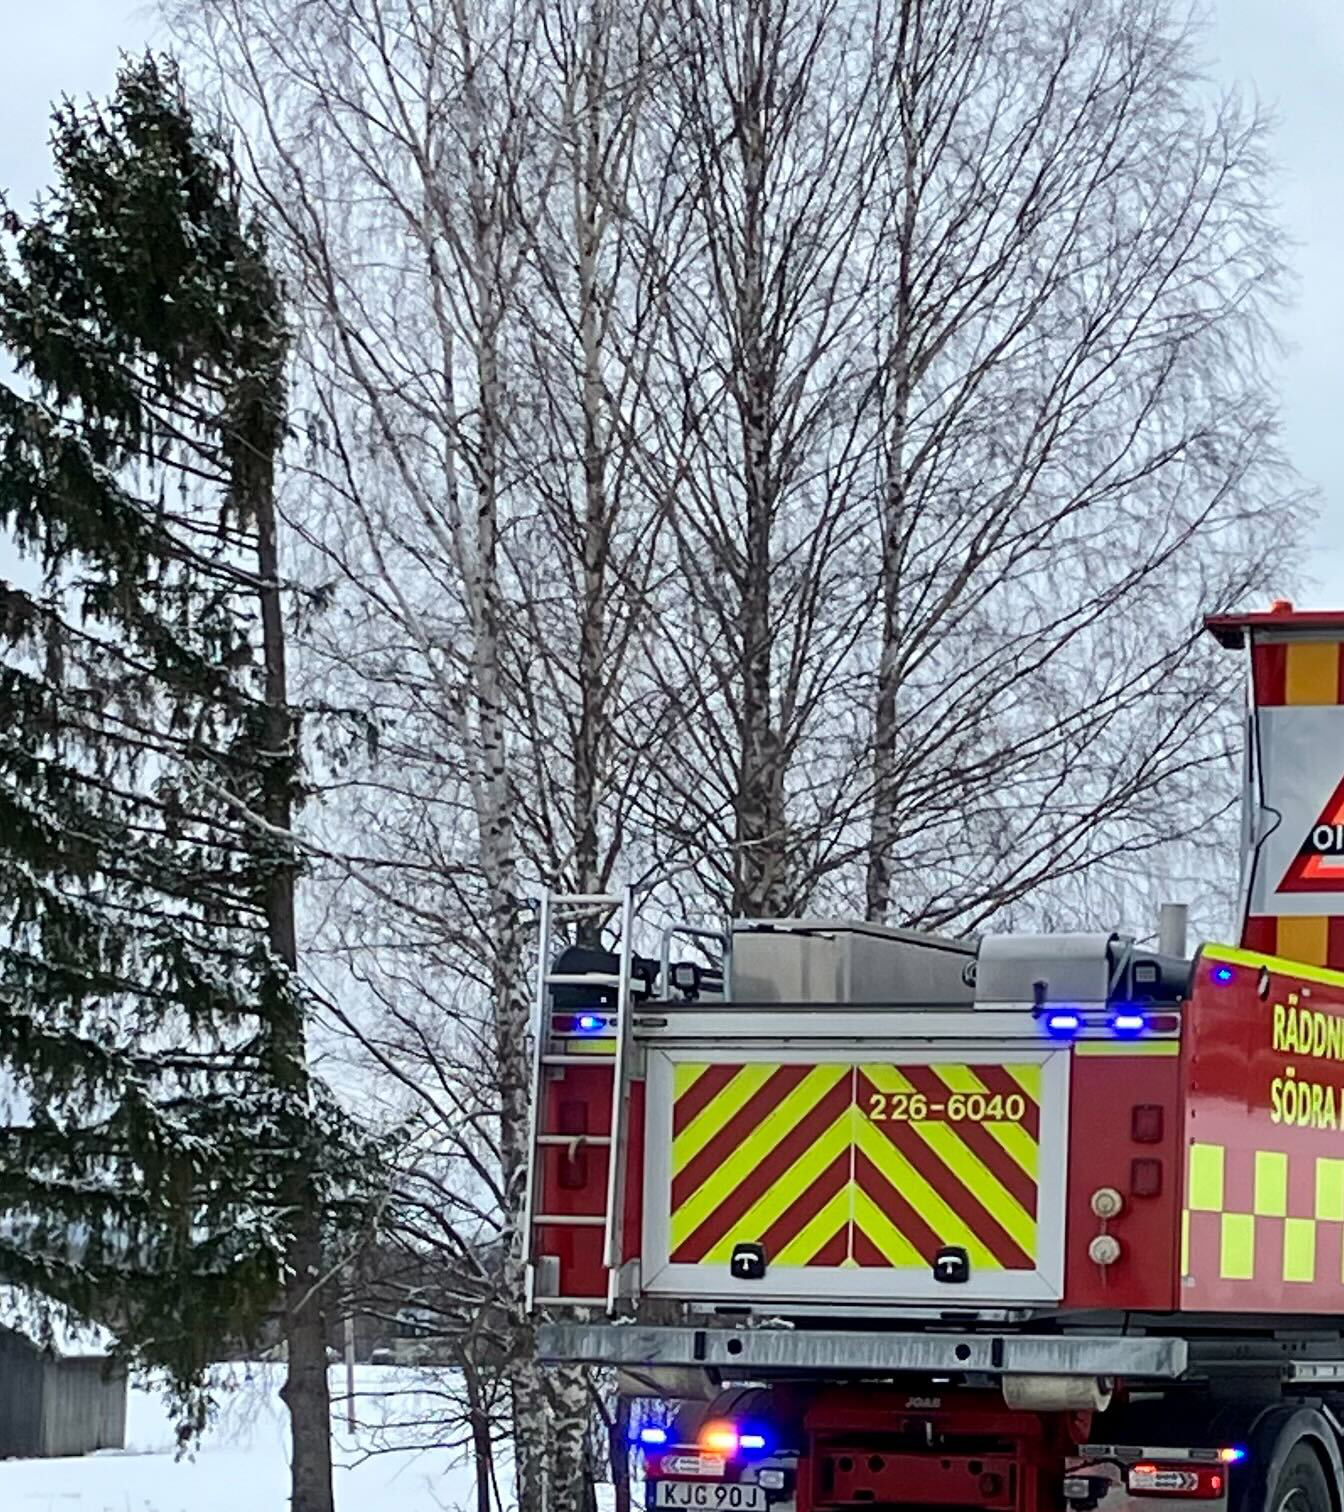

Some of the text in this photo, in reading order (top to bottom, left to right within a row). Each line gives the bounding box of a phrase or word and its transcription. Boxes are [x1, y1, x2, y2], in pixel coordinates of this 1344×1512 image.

[869, 1094, 1025, 1121] 226-6040
[1271, 1066, 1337, 1131] SÖDRA
[664, 1484, 757, 1508] KJG 90J
